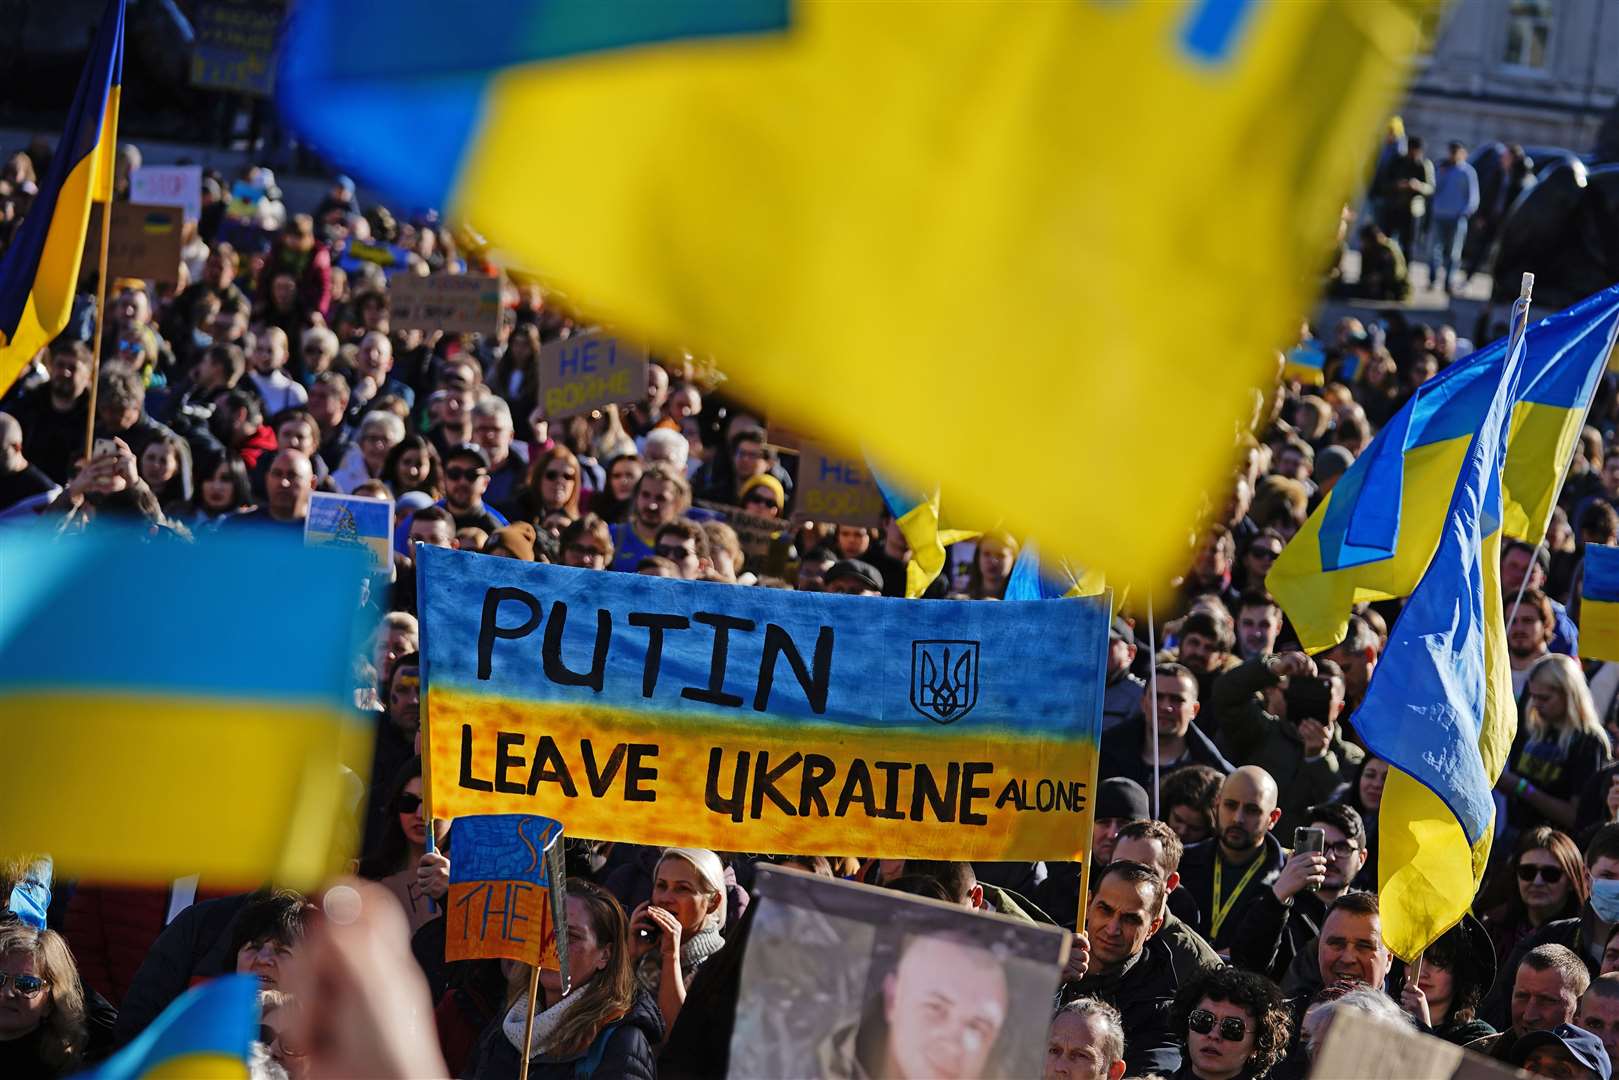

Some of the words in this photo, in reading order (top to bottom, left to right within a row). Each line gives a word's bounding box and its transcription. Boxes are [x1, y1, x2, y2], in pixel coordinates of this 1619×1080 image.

[476, 586, 834, 715] PUTIN
[459, 723, 660, 802] LEAVE
[705, 747, 994, 825] UKRAINE
[995, 778, 1088, 813] ALONE
[455, 882, 533, 942] THE
